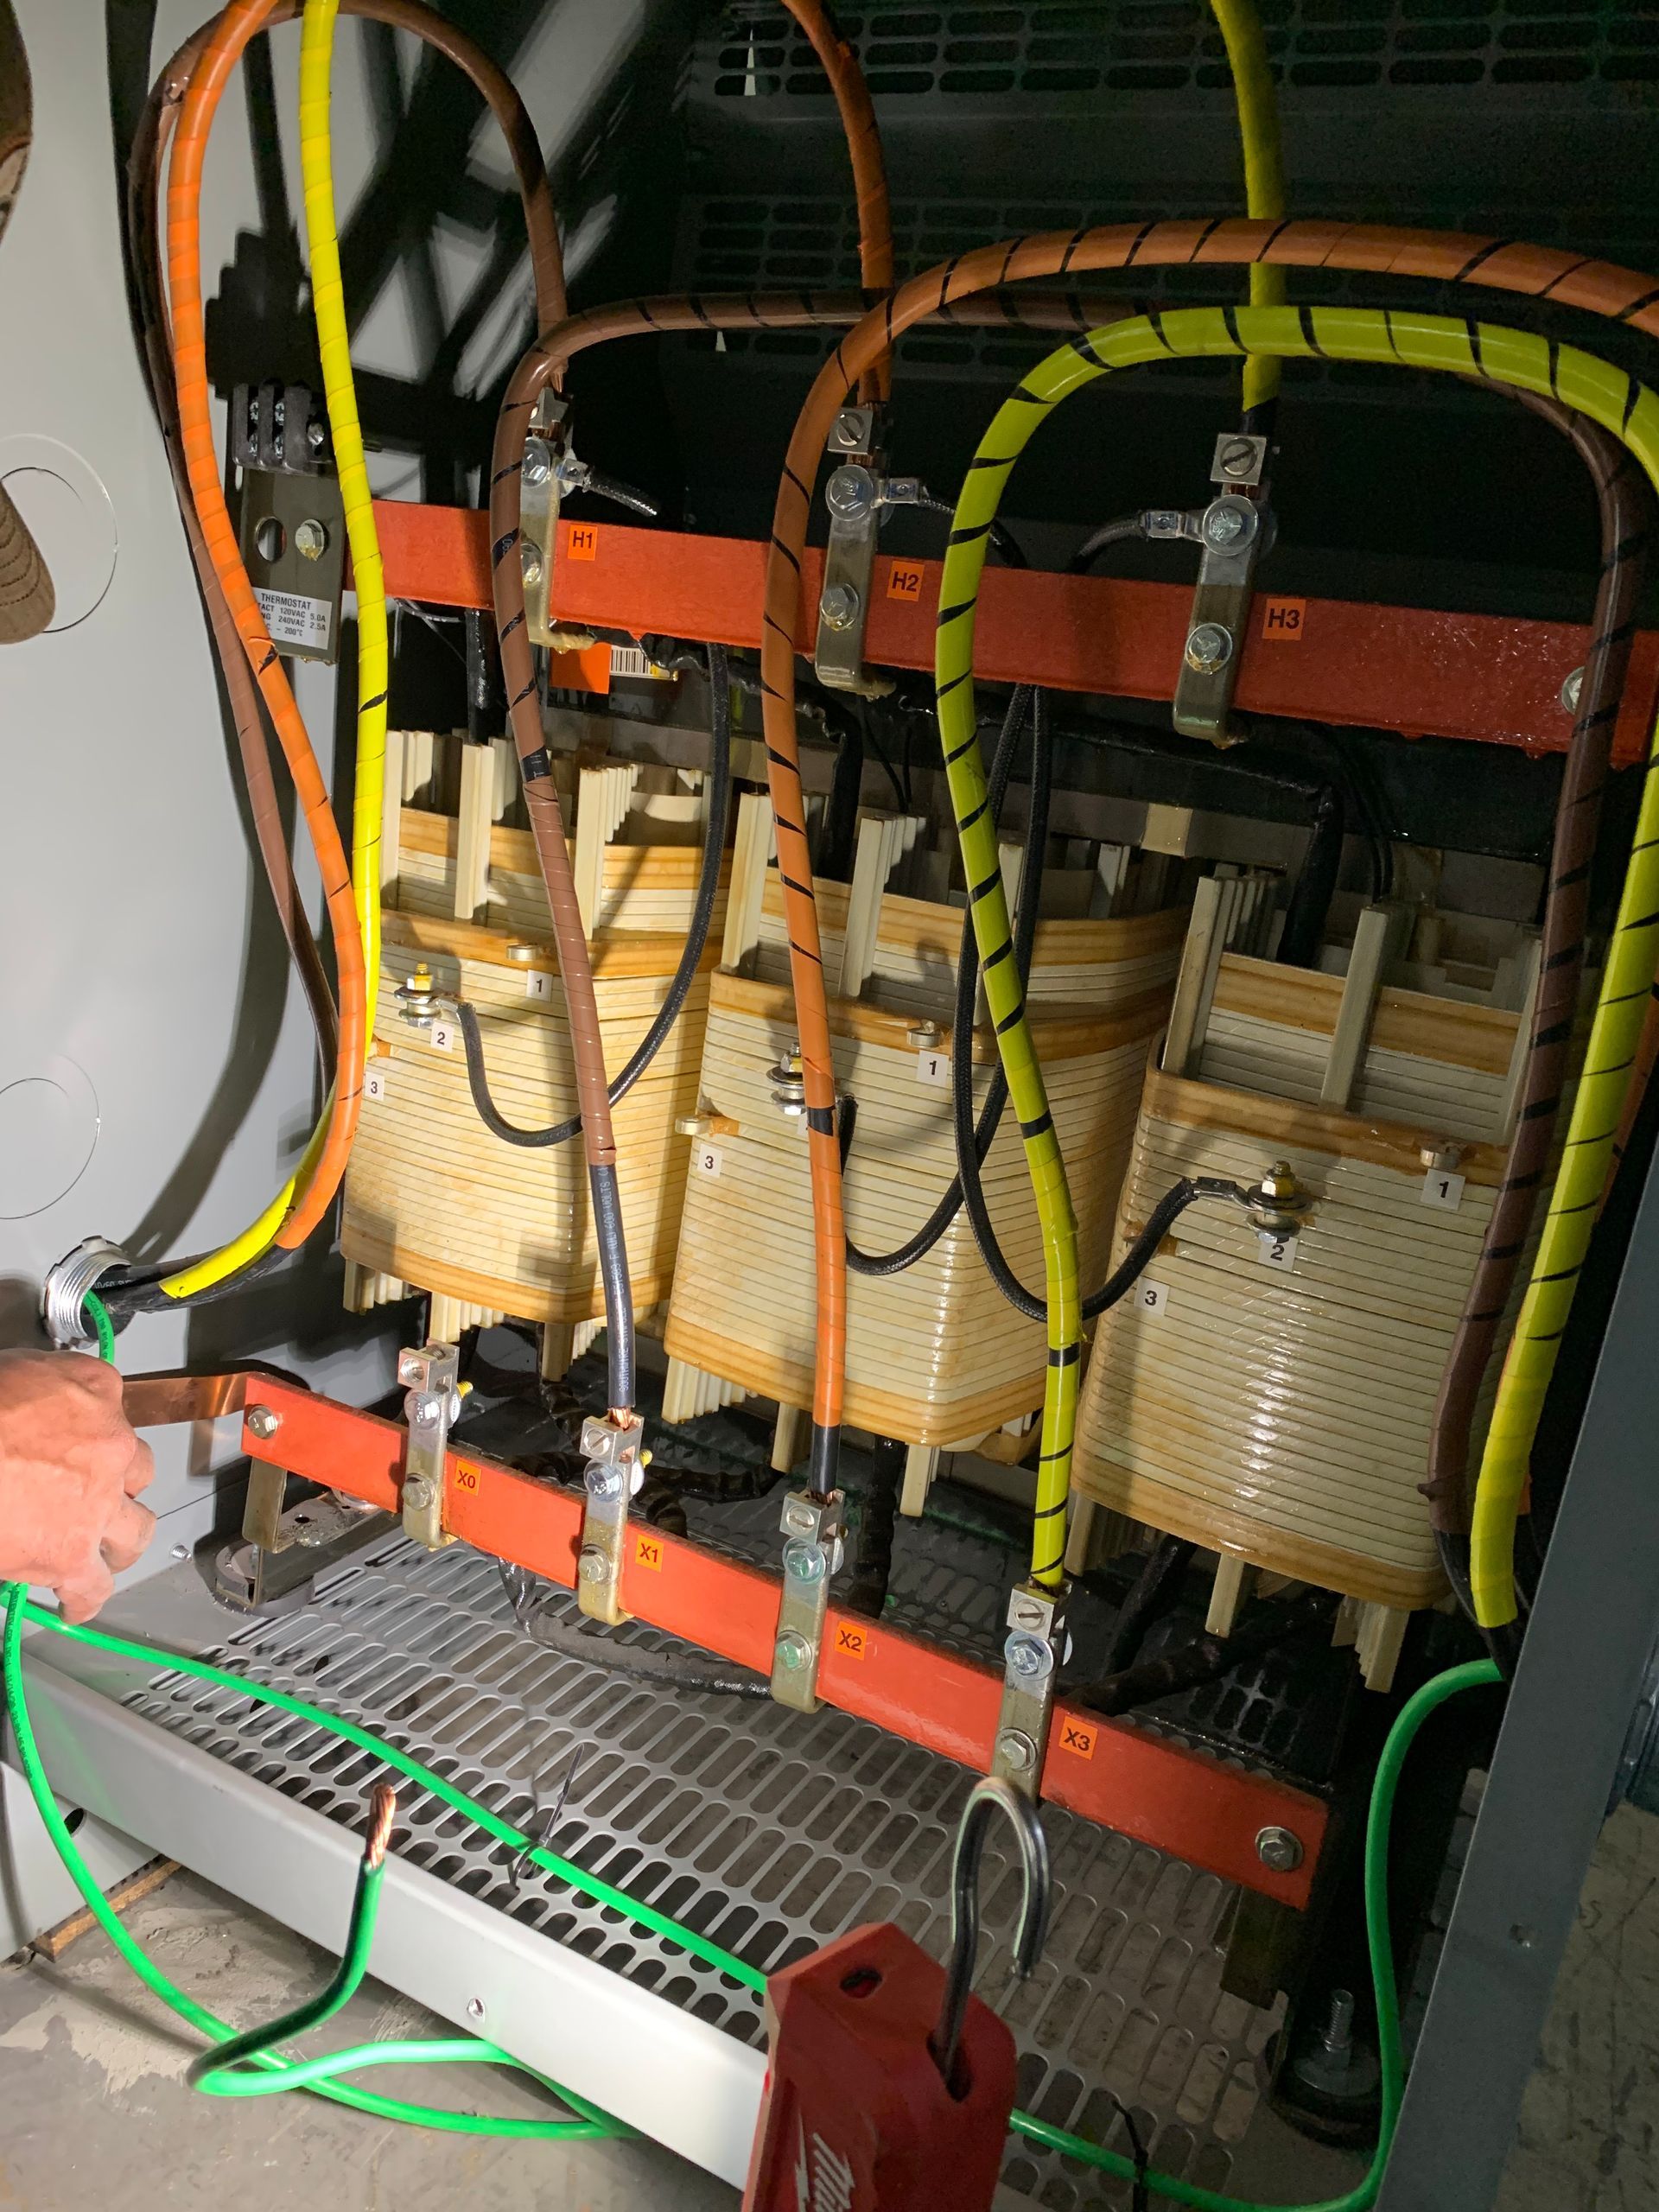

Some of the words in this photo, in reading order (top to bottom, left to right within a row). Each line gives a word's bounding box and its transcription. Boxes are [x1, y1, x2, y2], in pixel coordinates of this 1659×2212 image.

[572, 530, 593, 550] H1
[892, 570, 919, 593] H2
[261, 593, 312, 611] THERMOSTAT
[278, 615, 305, 628] 240VAC
[309, 621, 326, 632] 2.5A
[280, 607, 306, 619] 120VAC
[309, 613, 326, 623] 5.0A
[1268, 607, 1300, 630] H3
[536, 978, 543, 994] 1
[436, 1031, 446, 1046] 2
[929, 1059, 938, 1076] 1
[370, 1081, 378, 1095] 3
[704, 1155, 715, 1170] 3
[1439, 1180, 1450, 1198] 1
[1270, 1243, 1285, 1262] 2
[1144, 1289, 1158, 1306] 3
[457, 1469, 476, 1489] X0
[639, 1542, 658, 1563] X1
[838, 1630, 863, 1652] X2
[1063, 1727, 1090, 1751] X3
